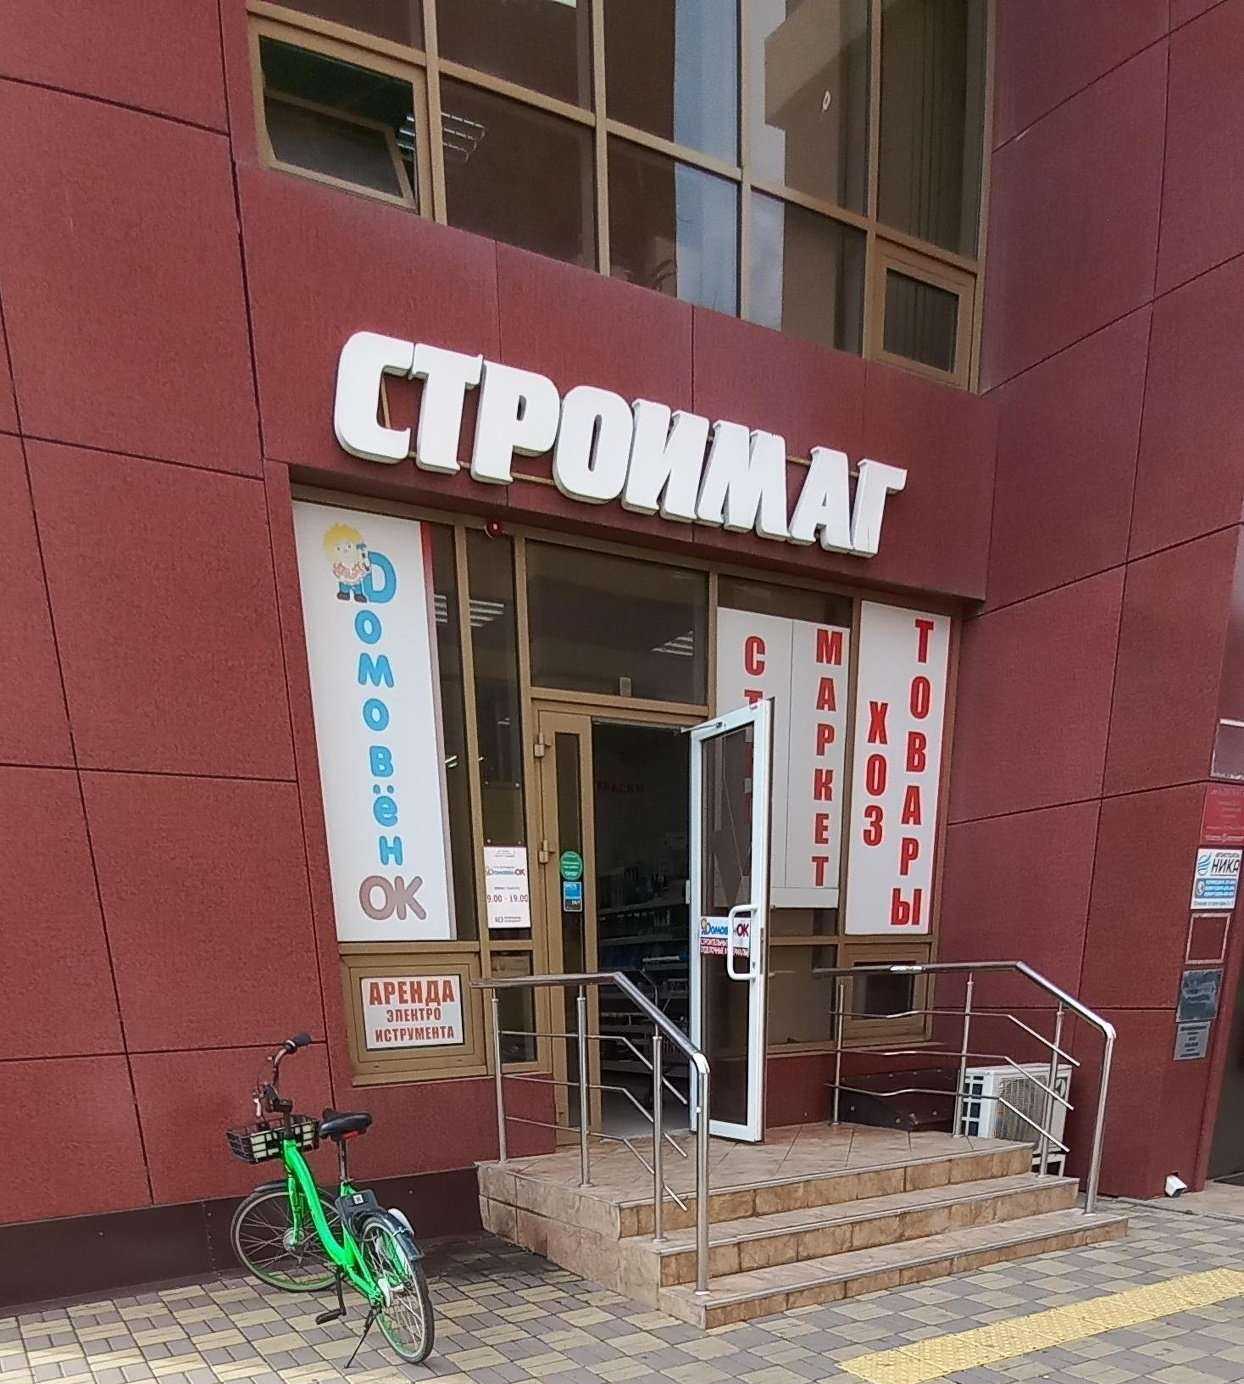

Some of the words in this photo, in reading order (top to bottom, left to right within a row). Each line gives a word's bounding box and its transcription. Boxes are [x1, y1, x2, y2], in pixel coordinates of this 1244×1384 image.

[811, 628, 843, 887] МАРКЕТ
[863, 701, 889, 846] ХОЗ
[890, 618, 935, 926] ТОВАРЫ
[359, 875, 427, 921] ОК
[369, 980, 455, 1006] АРЕНДА
[375, 1025, 455, 1043] ИСТРУМЕНТА
